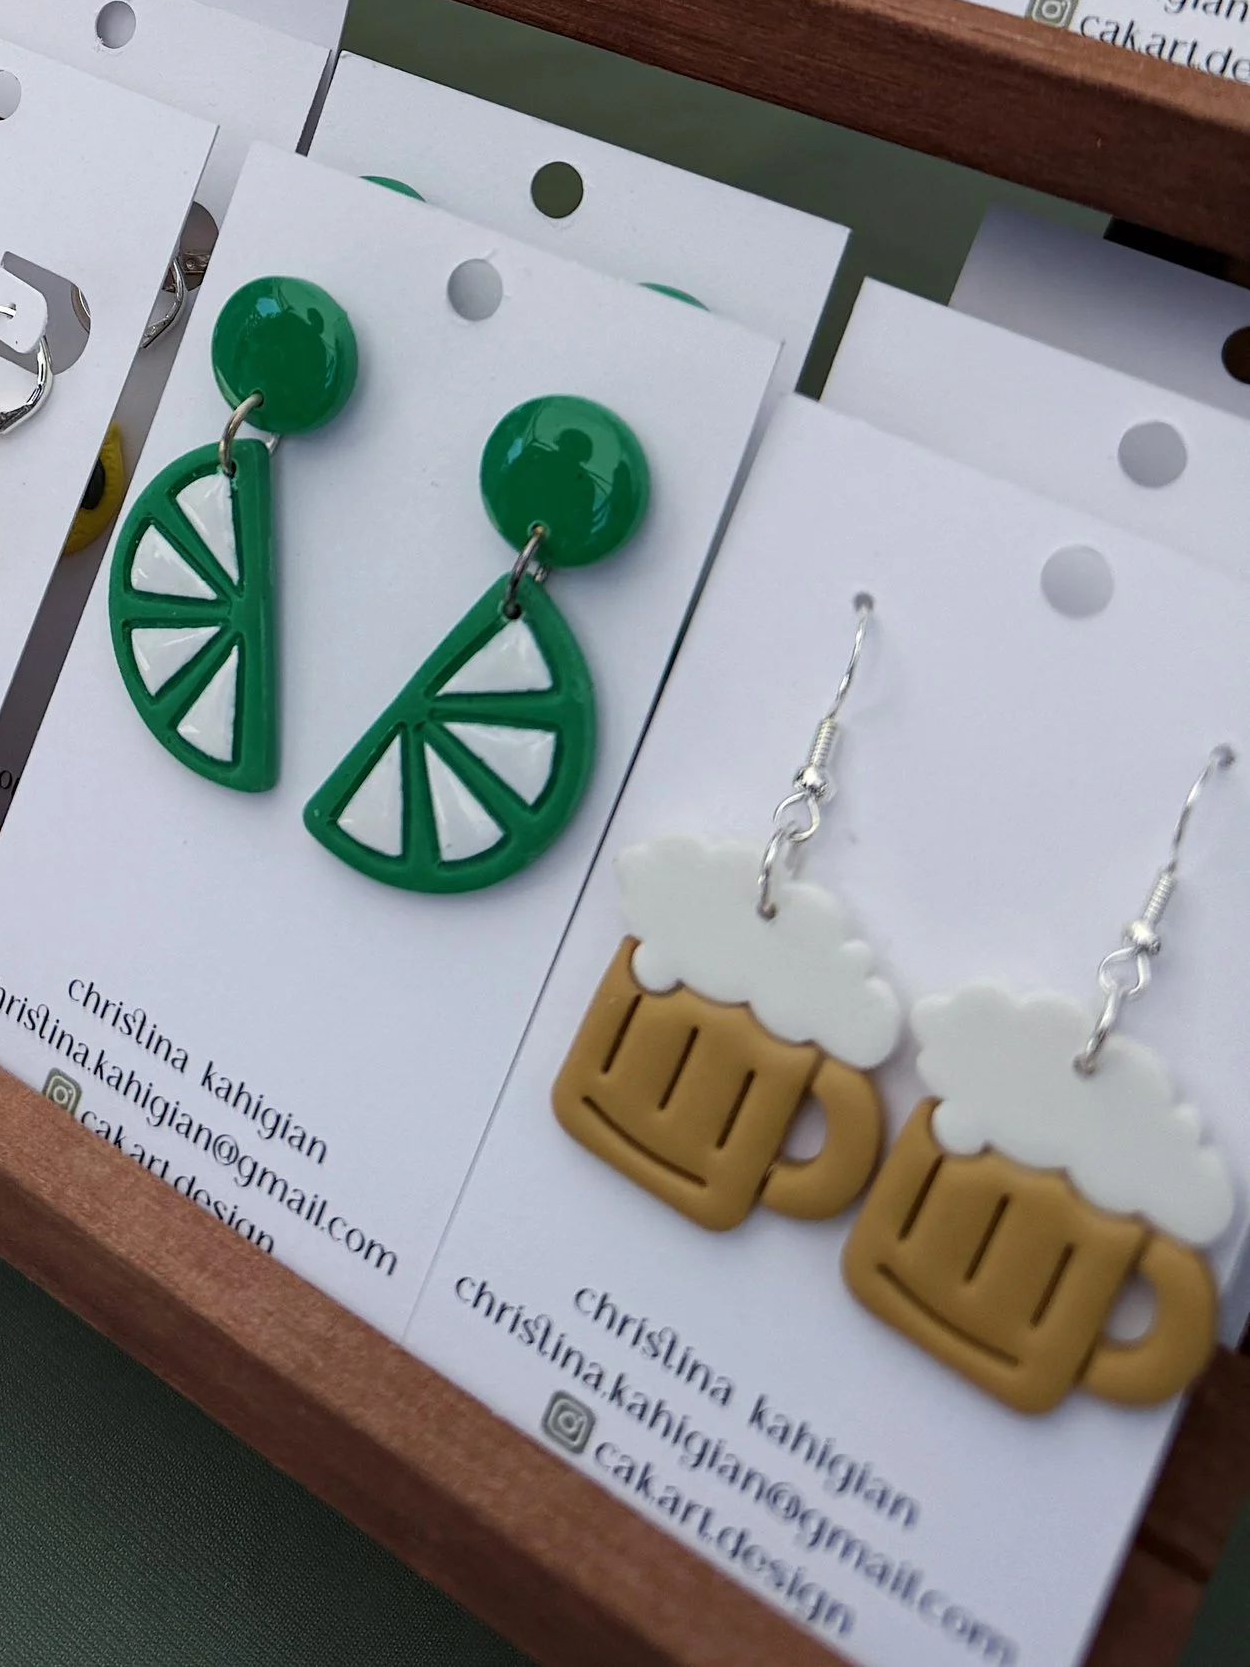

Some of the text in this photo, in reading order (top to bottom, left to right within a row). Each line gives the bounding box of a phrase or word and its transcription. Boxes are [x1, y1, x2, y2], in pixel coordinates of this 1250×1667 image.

[68, 978, 328, 1165] christina kahigian
[454, 1274, 1020, 1667] christina.kahigian@gmail.com
[573, 1285, 920, 1528] christina kahigian
